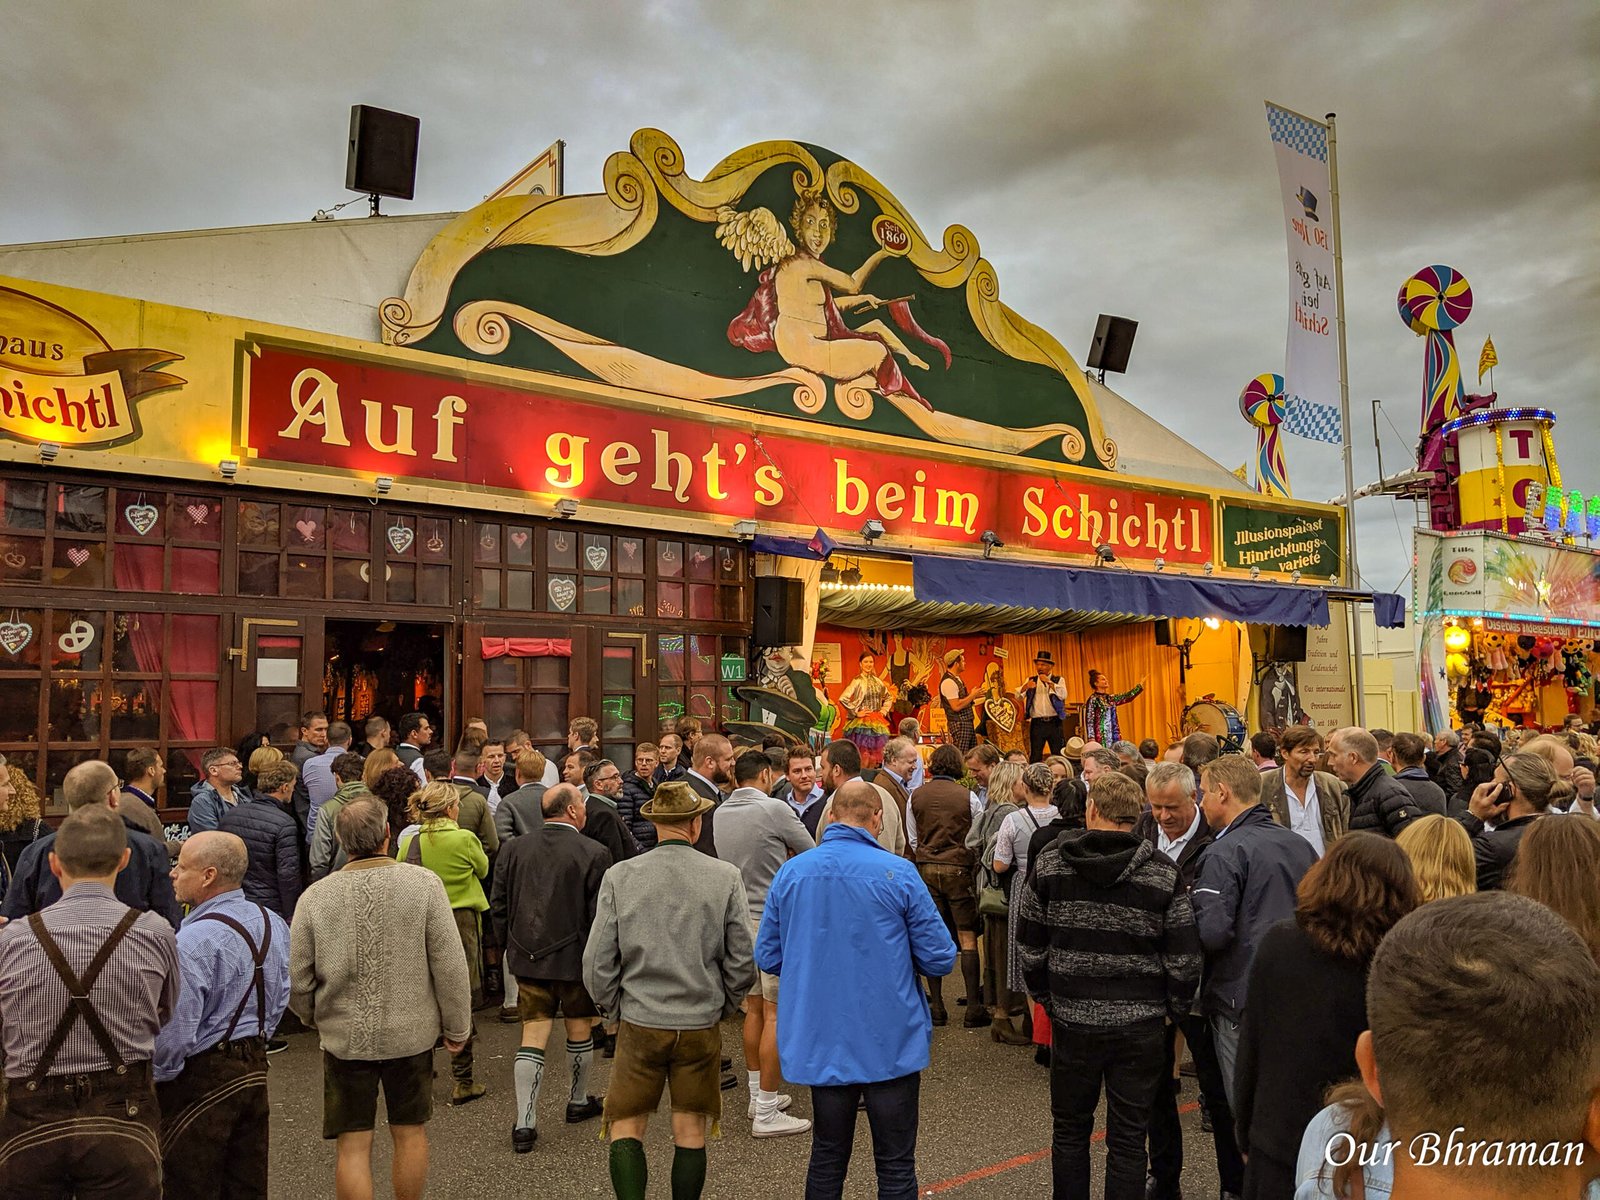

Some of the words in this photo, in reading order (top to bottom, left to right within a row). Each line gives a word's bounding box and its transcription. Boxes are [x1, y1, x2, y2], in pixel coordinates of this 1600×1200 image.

[879, 227, 906, 245] 1869
[884, 221, 900, 234] Seit
[277, 367, 468, 463] Auf
[544, 428, 785, 507] geht's
[833, 457, 980, 535] beim
[1021, 486, 1202, 554] Schichtl
[1278, 549, 1321, 573] varieté
[721, 665, 743, 679] W1
